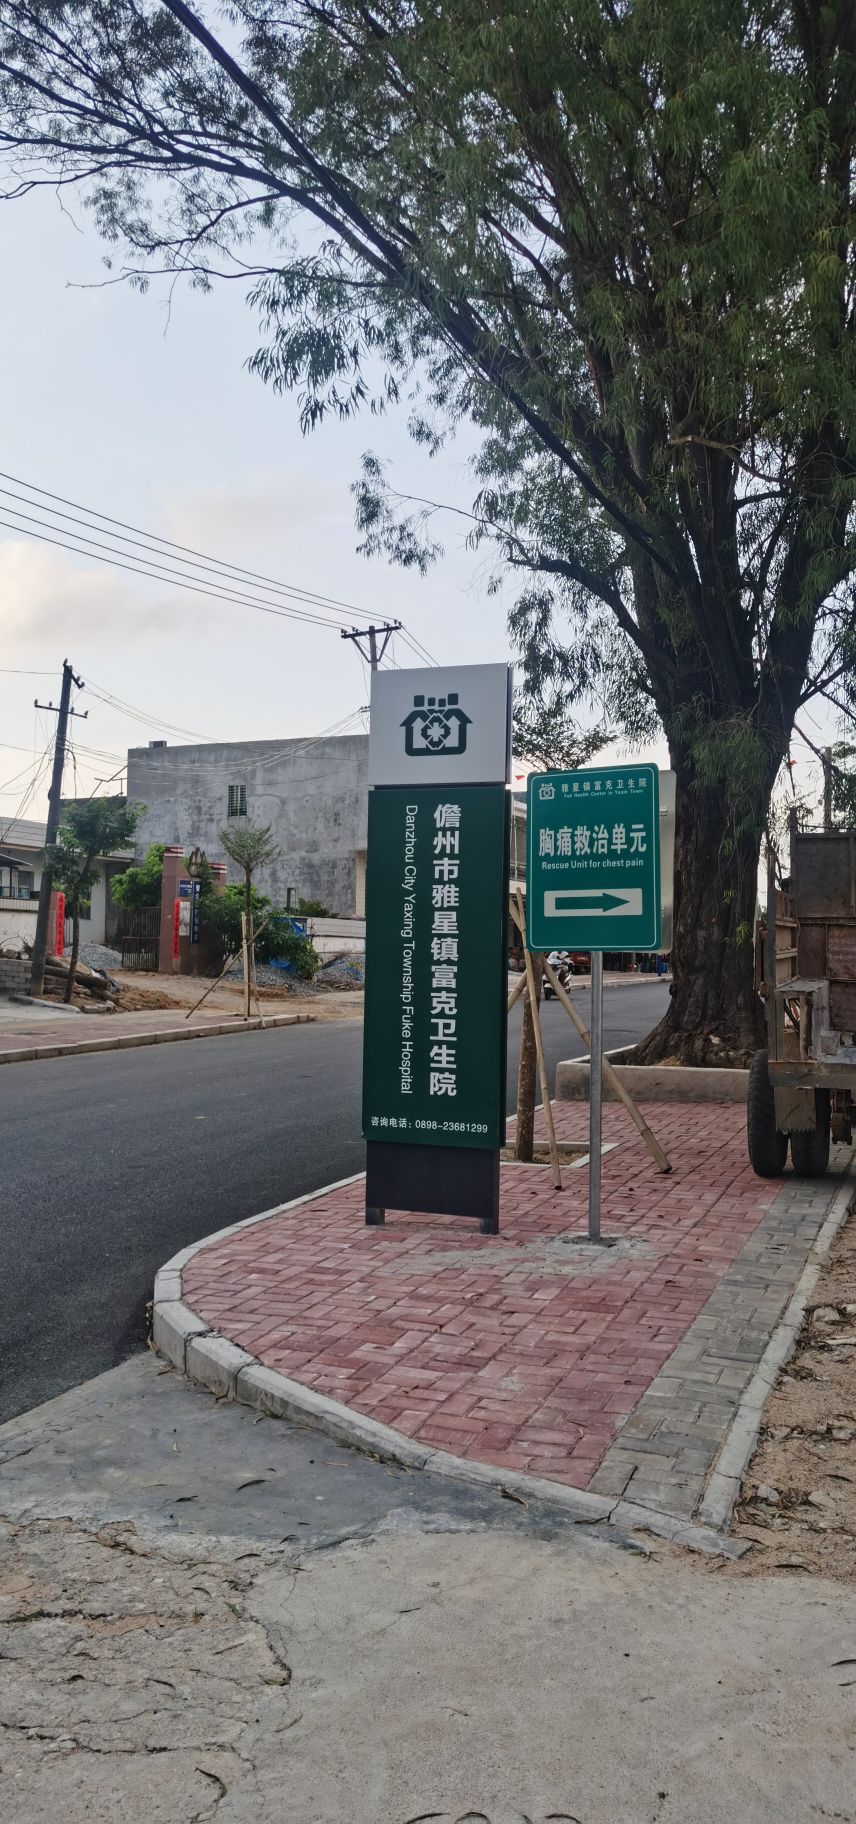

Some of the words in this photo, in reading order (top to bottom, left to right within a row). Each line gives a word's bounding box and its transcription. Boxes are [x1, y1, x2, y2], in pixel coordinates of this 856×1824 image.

[561, 777, 647, 793] 雅星镇富克卫生院
[404, 805, 418, 863] Danzhou
[538, 823, 647, 857] 胸痛救治单元
[402, 865, 417, 891] City
[542, 861, 569, 870] Rescue
[570, 859, 588, 869] Unit
[589, 859, 601, 868] for
[602, 858, 624, 868] chest
[626, 858, 644, 868] pain
[401, 893, 416, 938] Yaxing
[429, 803, 462, 1096] 儋州市雅星镇富克卫生院
[400, 940, 415, 1003] Township
[401, 1006, 414, 1038] Fuke
[399, 1041, 414, 1094] Hospital
